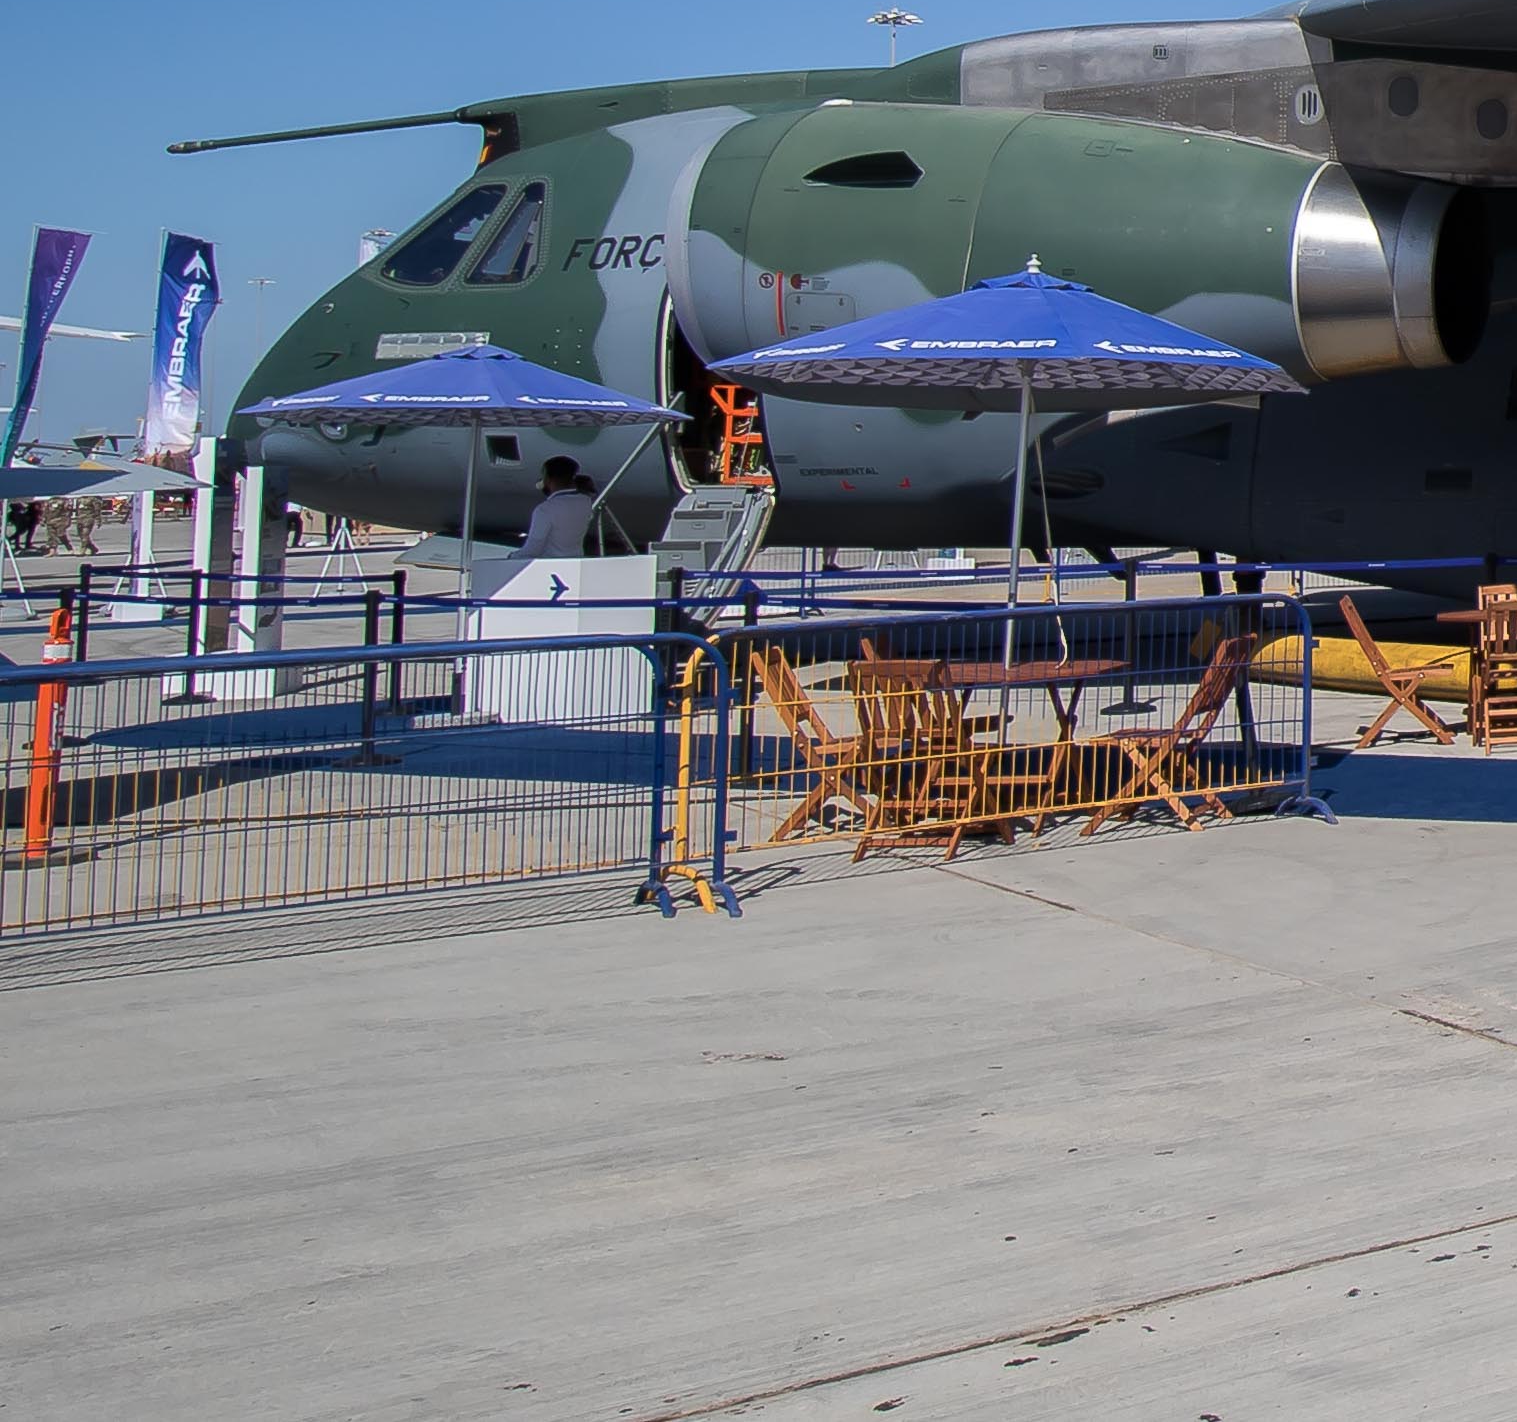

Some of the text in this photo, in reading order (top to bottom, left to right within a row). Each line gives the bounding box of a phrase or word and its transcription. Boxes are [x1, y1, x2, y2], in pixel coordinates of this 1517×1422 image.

[561, 233, 666, 274] FORÇ
[162, 281, 206, 420] EMBRAER
[910, 339, 1057, 349] EMBRAER
[384, 394, 491, 403] EMBRAER
